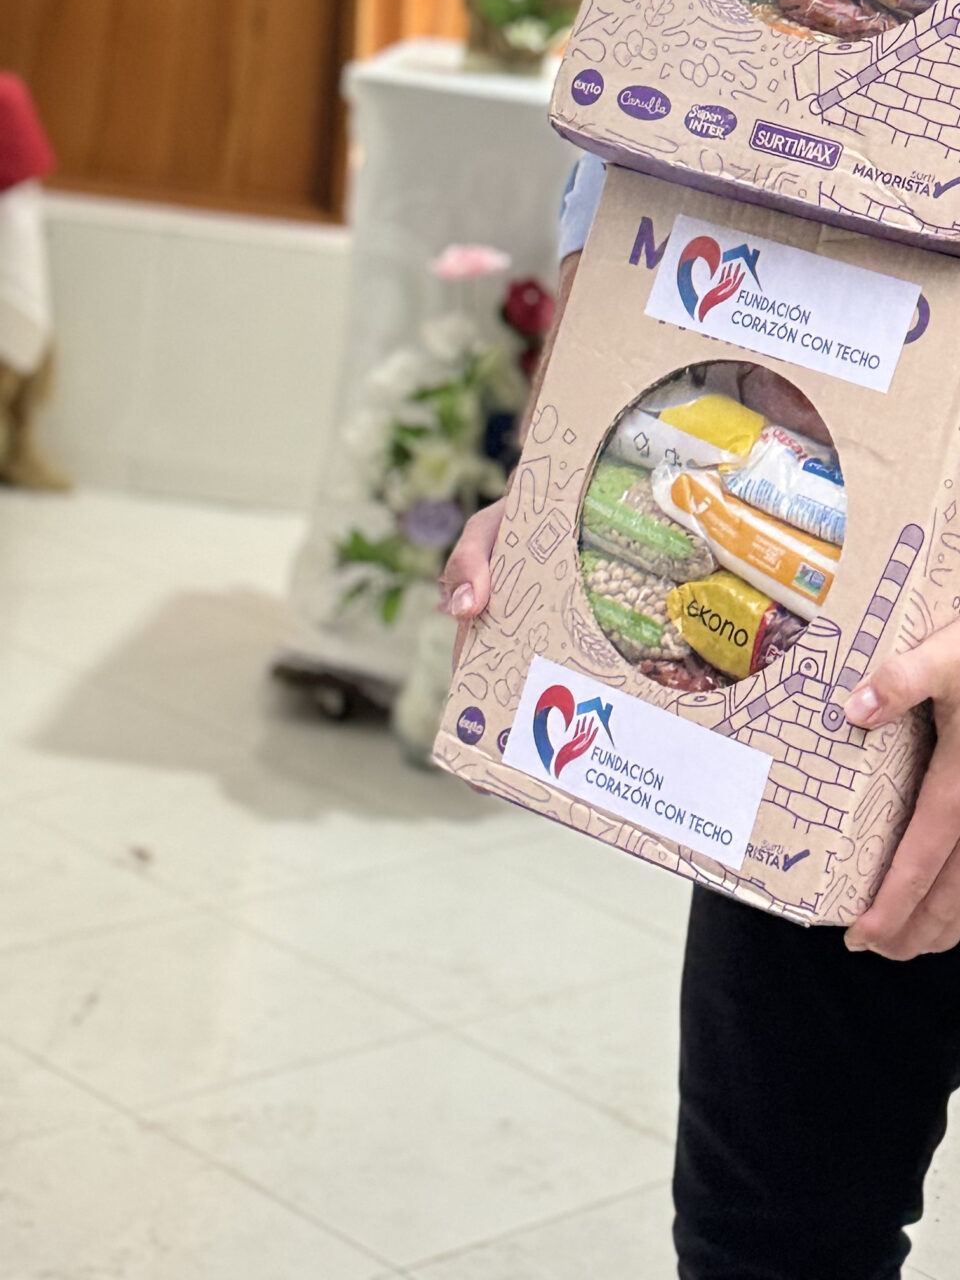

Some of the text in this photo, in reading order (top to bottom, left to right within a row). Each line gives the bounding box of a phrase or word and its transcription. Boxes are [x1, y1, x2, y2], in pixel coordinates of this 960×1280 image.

[620, 90, 667, 115] Carulla
[688, 120, 726, 140] INTER
[755, 130, 836, 165] SURTIMAX
[852, 163, 931, 198] MAYORISTA
[736, 289, 812, 325] FUNDACIÓN
[731, 310, 880, 370] CORAZÓN CON TECHO
[686, 599, 749, 647] ekono
[590, 745, 664, 791] FUNDACIÓN
[585, 768, 733, 846] CORAZÓN CON TECHO
